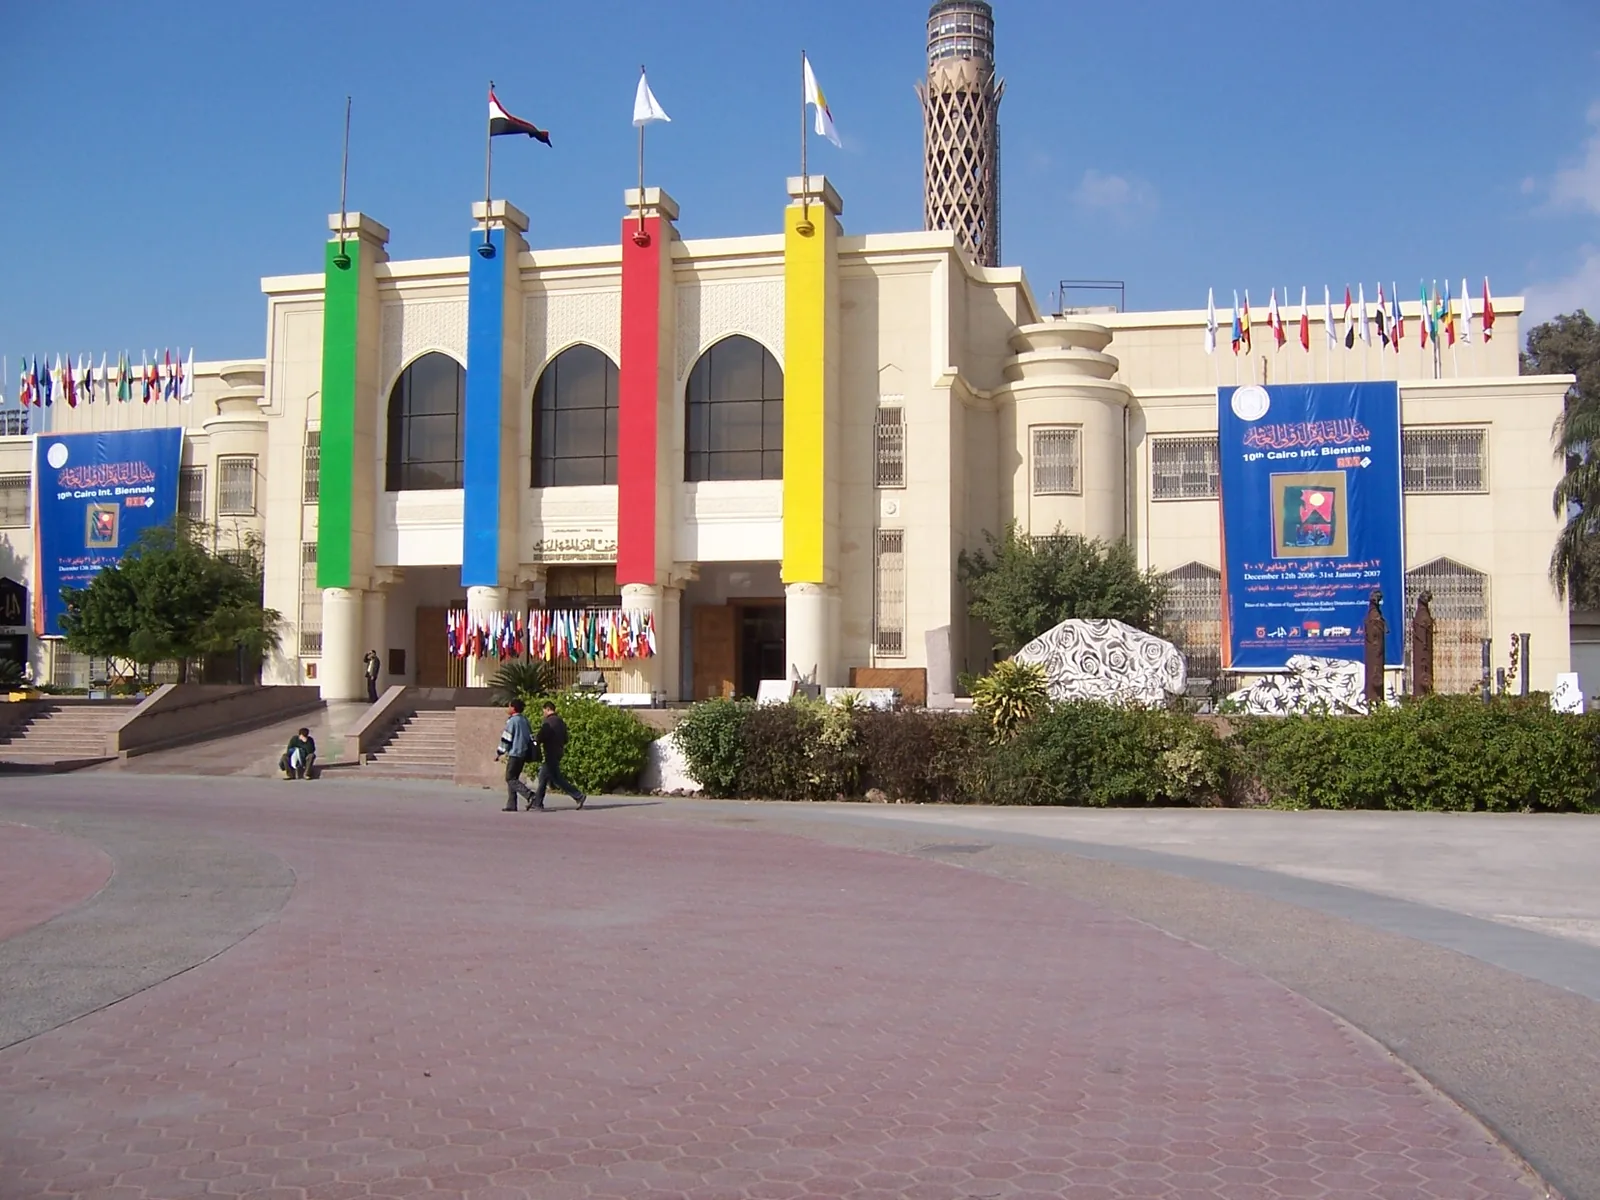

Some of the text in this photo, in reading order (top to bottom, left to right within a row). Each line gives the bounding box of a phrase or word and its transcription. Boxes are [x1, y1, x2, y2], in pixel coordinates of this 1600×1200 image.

[1243, 444, 1372, 462] 10th Cairo Int. Biennale
[57, 485, 155, 500] 10th Cairo Int. Biennale
[1244, 572, 1279, 580] December
[1281, 572, 1296, 580] 12th
[1319, 571, 1334, 579] 31st
[1335, 571, 1362, 579] January
[1363, 570, 1381, 578] 2007
